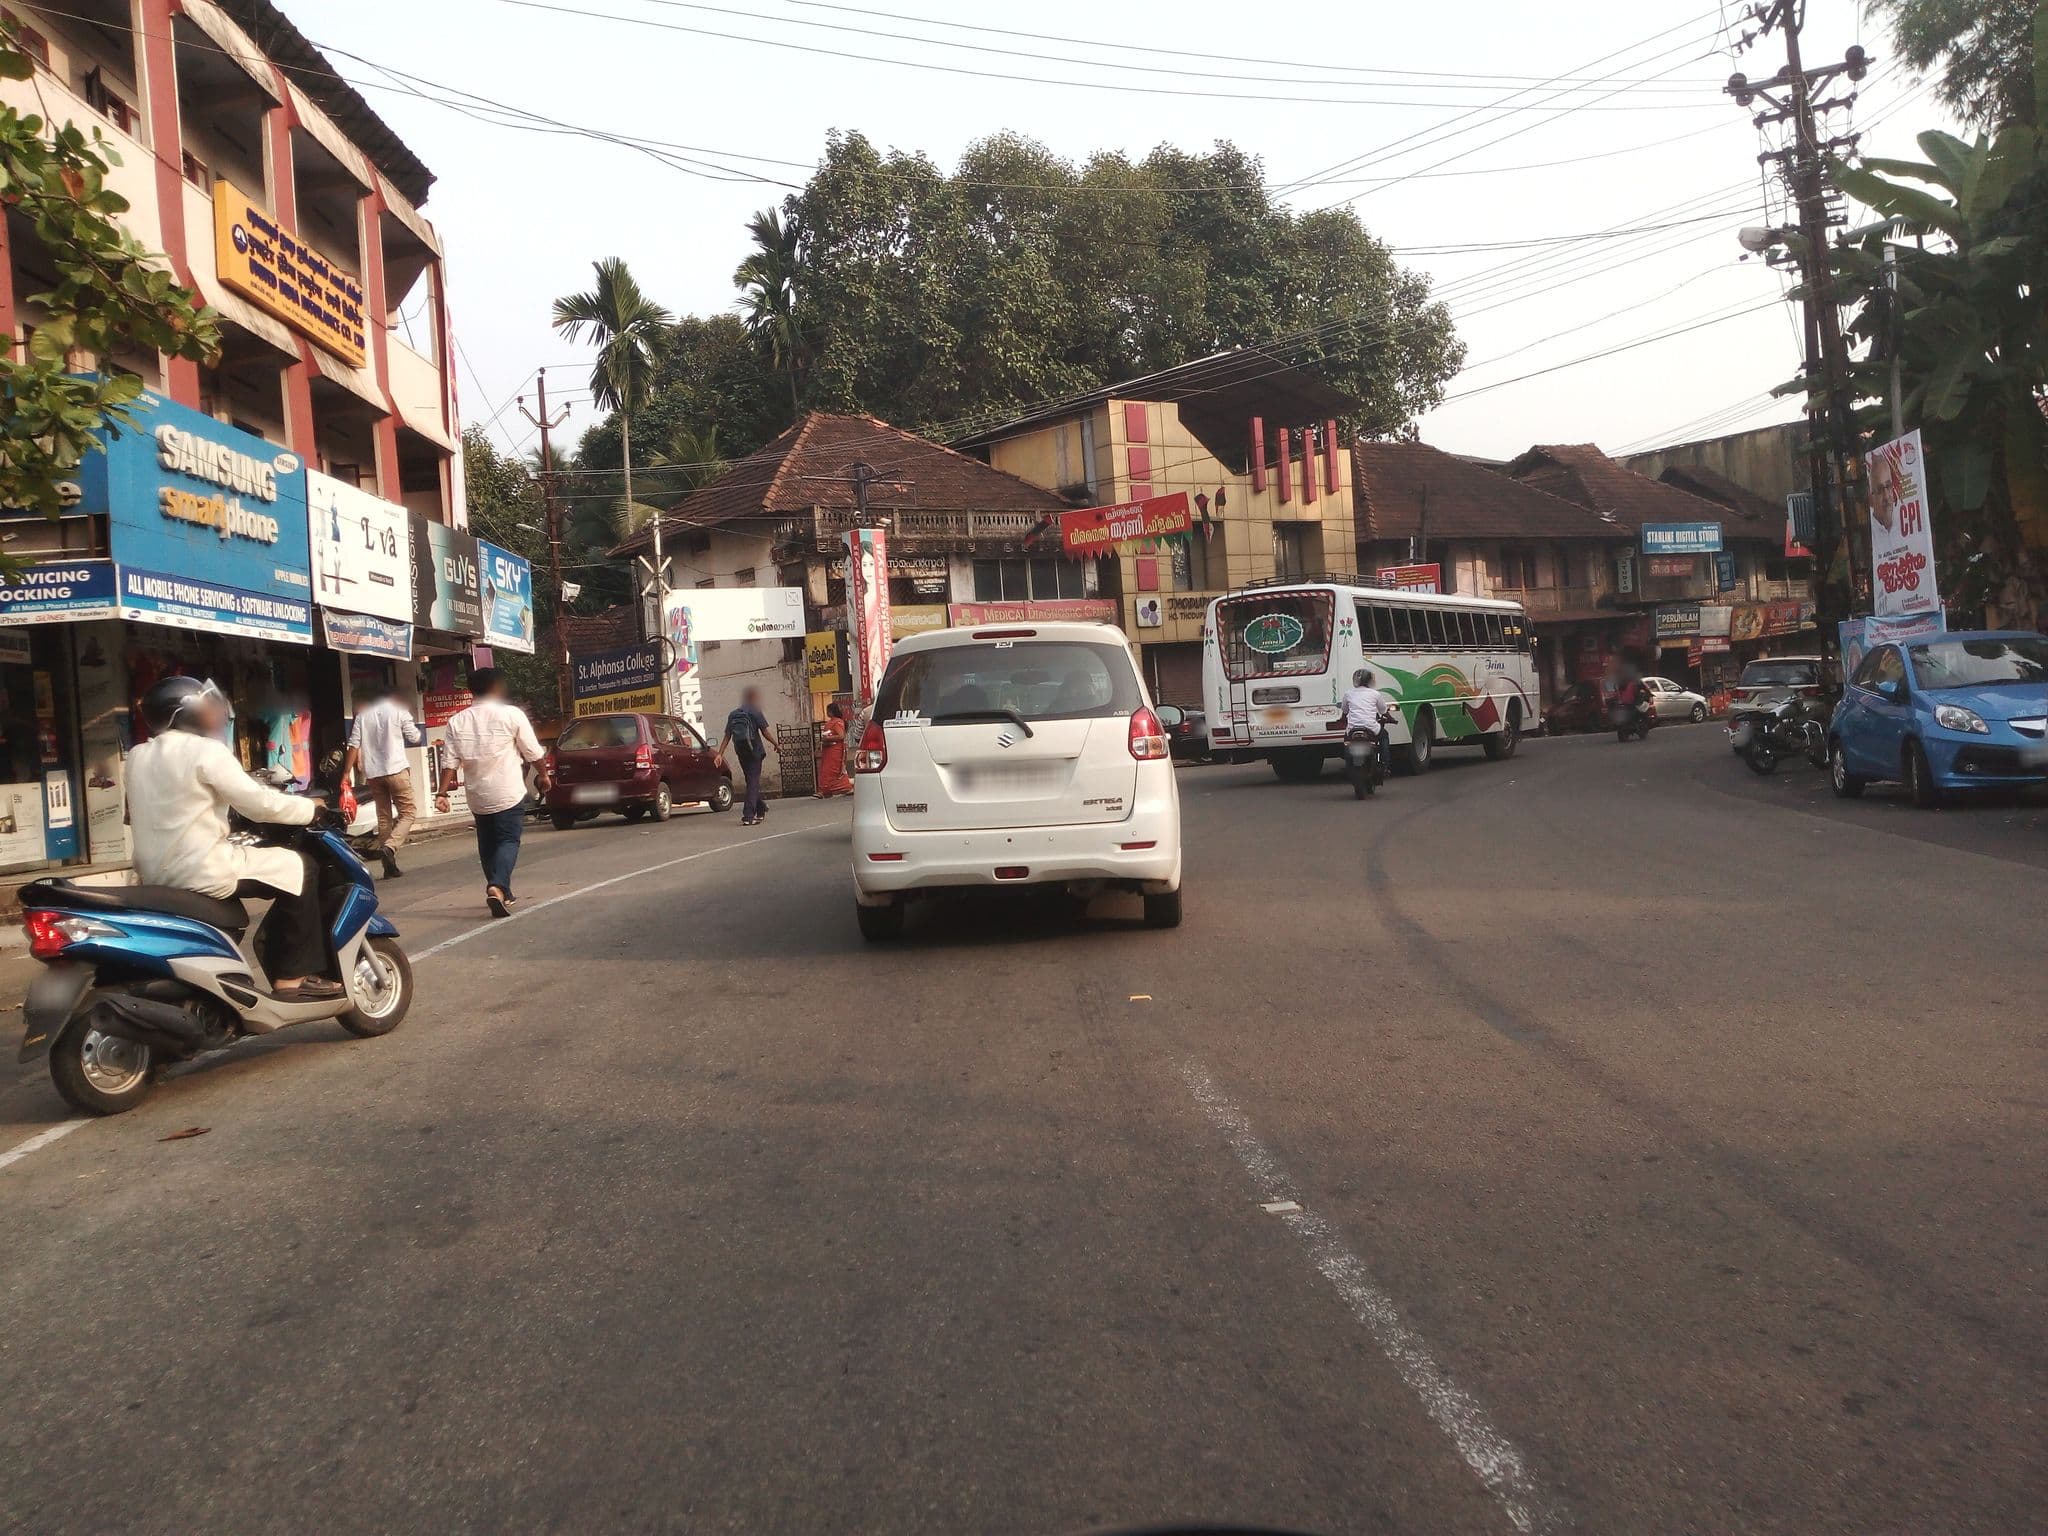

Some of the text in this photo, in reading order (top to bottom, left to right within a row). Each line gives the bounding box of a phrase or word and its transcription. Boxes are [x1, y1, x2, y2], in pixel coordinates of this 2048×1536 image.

[156, 424, 277, 502] SAMSUNG
[159, 486, 279, 544] smartphone
[1900, 501, 1923, 538] CPI
[1675, 531, 1697, 543] DIGITAL
[1698, 530, 1719, 542] STUDIO
[0, 570, 91, 586] SVICING
[443, 555, 477, 589] GUYS
[495, 557, 521, 592] SKY
[22, 603, 45, 611] Mobile
[69, 600, 110, 608] Exchanging
[128, 574, 142, 595] ALL
[143, 578, 173, 599] MOBILE
[173, 583, 200, 604] PHONE
[200, 588, 236, 610] SERVICING
[241, 597, 272, 618] SOFTWARE
[272, 602, 307, 623] UNLOCKING
[578, 665, 588, 679] St.
[590, 660, 625, 680] Alphonsa
[626, 652, 655, 671] College
[613, 697, 630, 711] Higher
[630, 693, 656, 708] Education
[1083, 797, 1123, 806] ERTIGA
